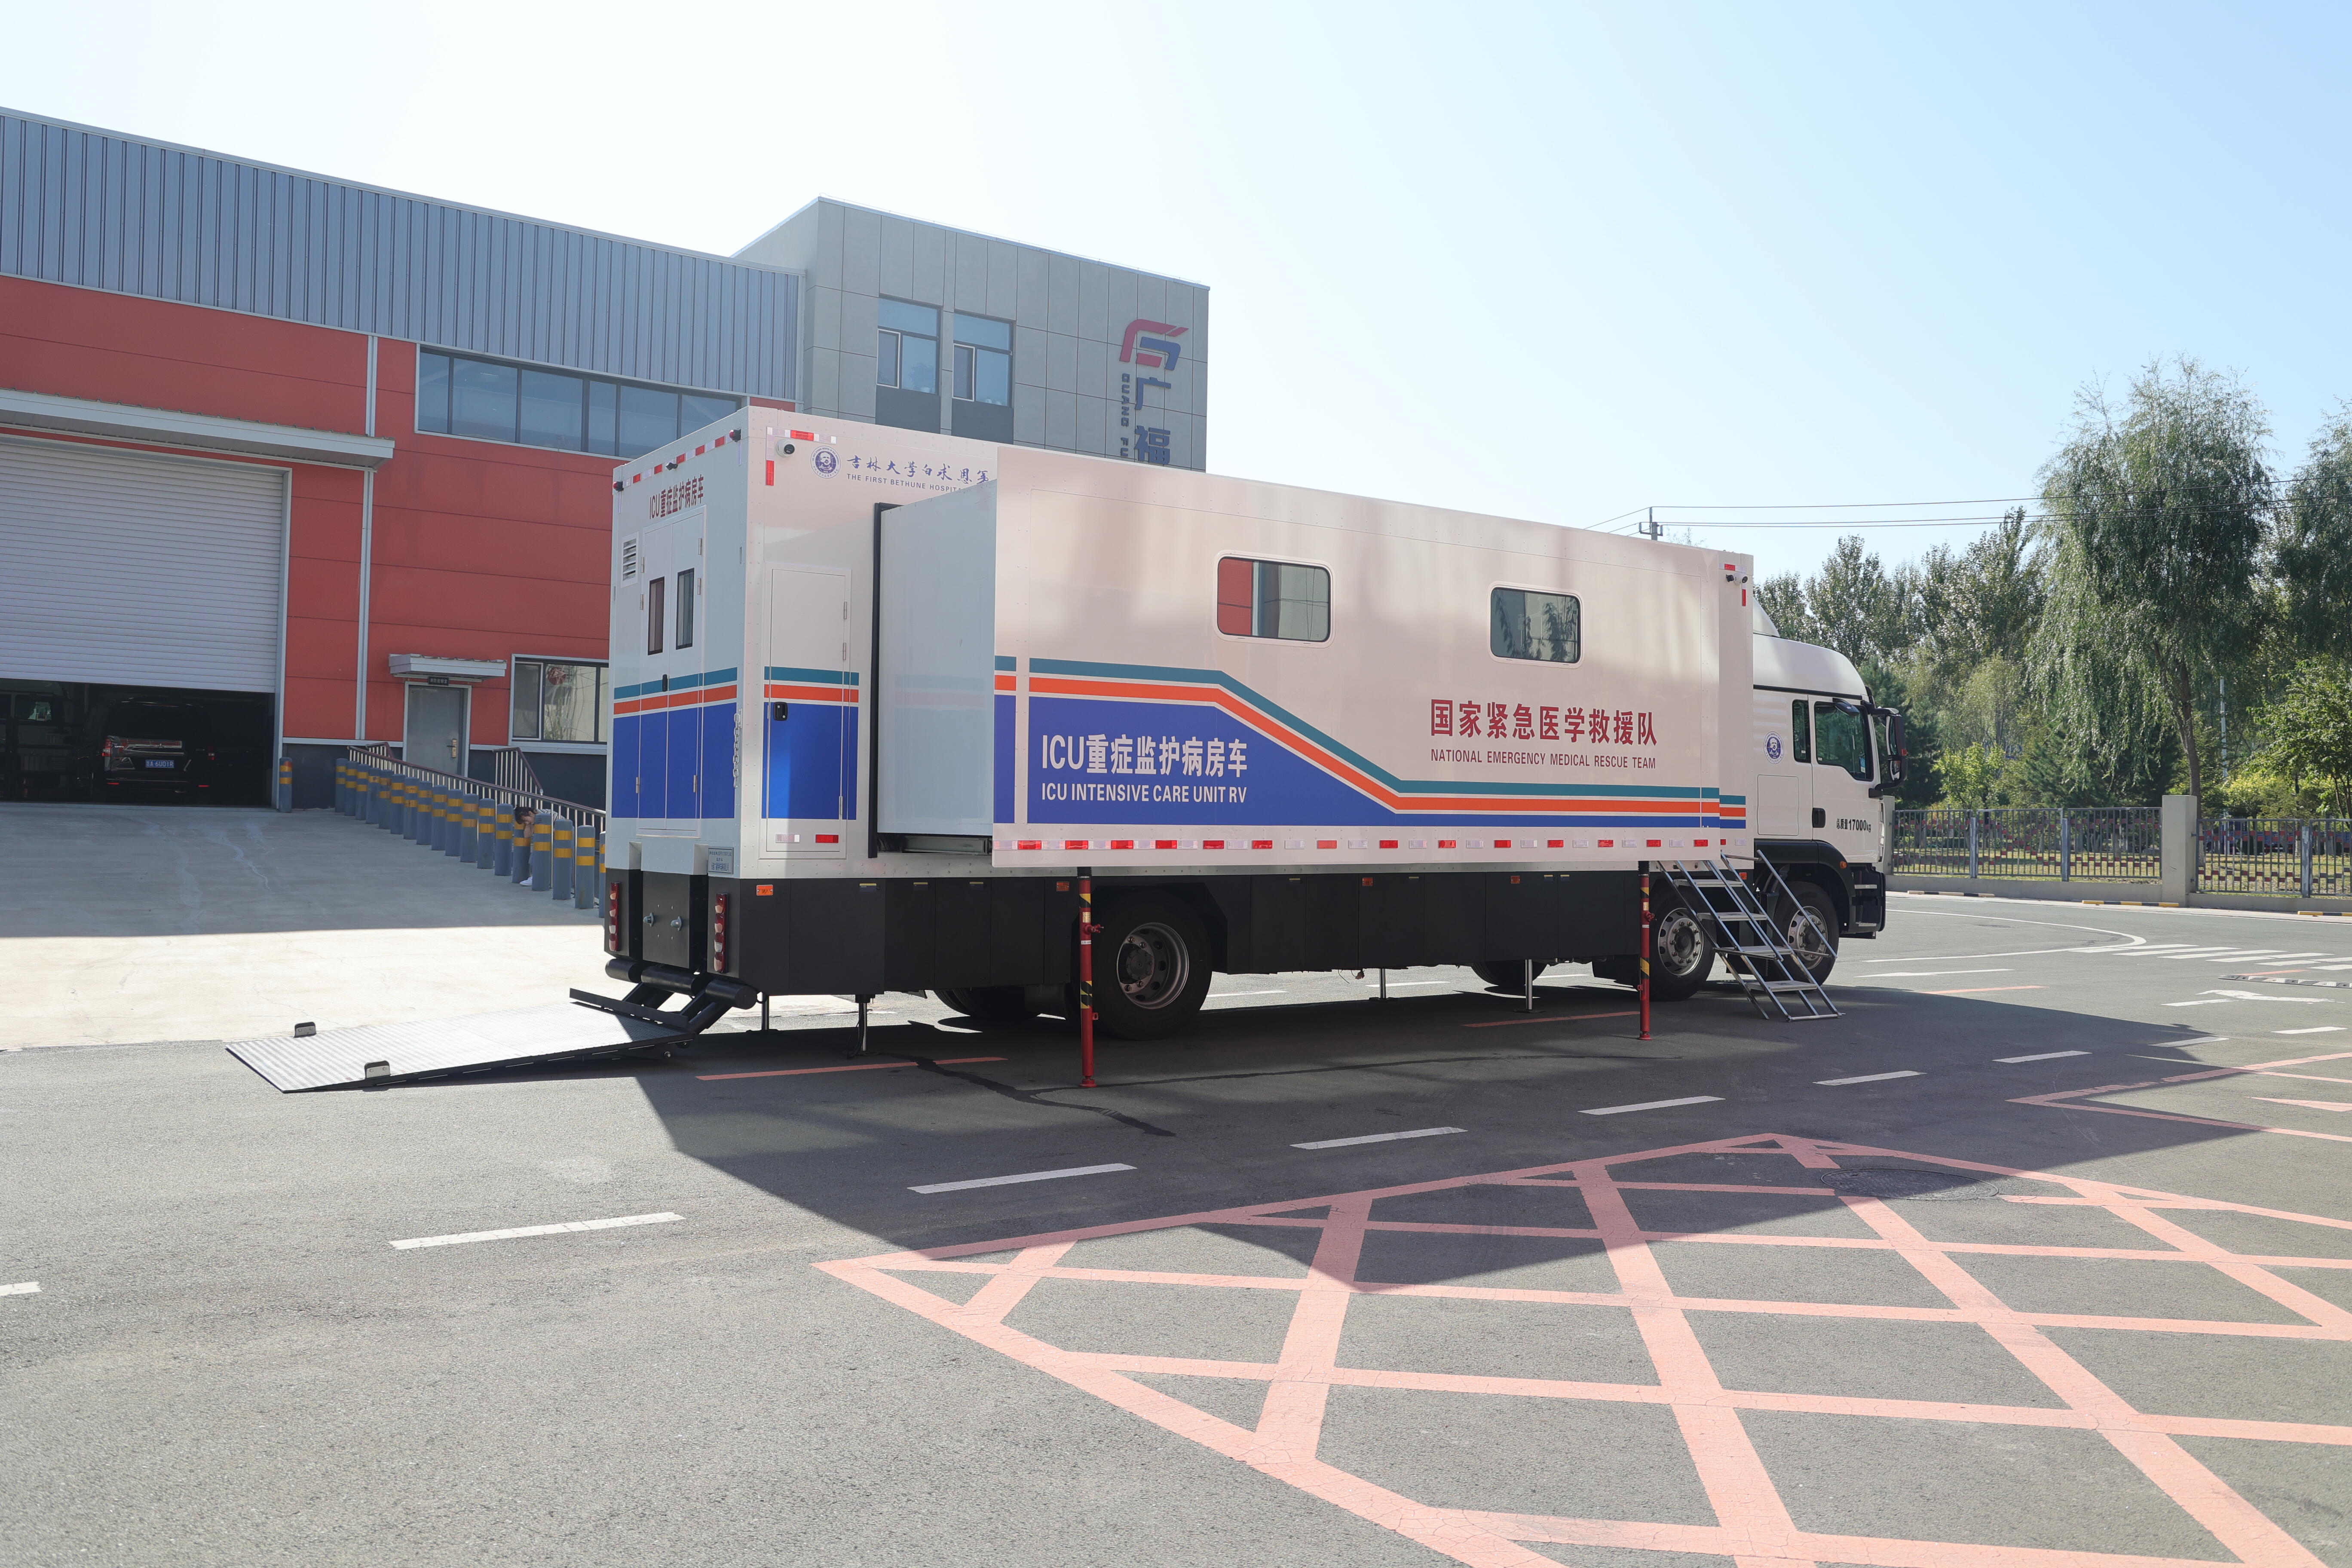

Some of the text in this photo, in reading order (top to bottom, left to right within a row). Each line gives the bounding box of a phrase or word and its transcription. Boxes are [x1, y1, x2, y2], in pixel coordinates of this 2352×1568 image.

[1120, 373, 1130, 456] GUANG FU
[1134, 377, 1172, 465] 广福
[649, 474, 704, 519] ICU重症监护病房车
[865, 476, 888, 484] FIRST
[890, 479, 926, 489] BETHUNE
[1431, 699, 1657, 746] 国家紧急医学救援队
[1042, 734, 1247, 778] ICU重症监护病房车
[1431, 749, 1656, 769] NATIONAL EMERGENCY MEDICAL RESCUE TEAM
[1042, 783, 1247, 803] ICU INTENSIVE CARE UNIT RV
